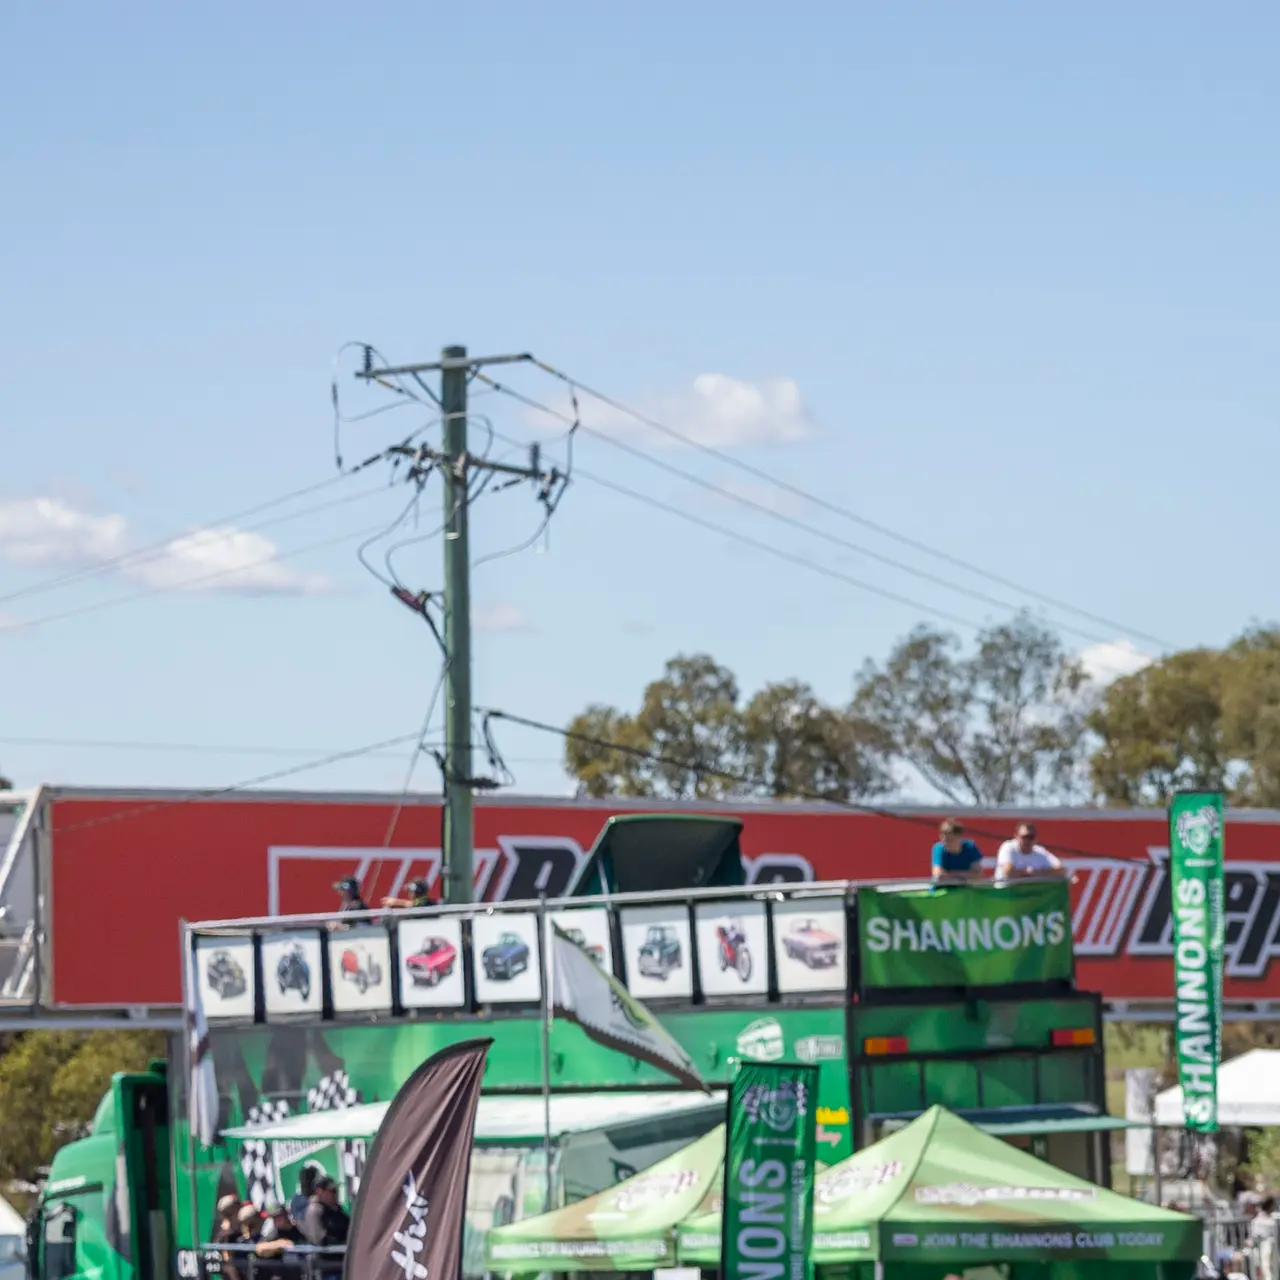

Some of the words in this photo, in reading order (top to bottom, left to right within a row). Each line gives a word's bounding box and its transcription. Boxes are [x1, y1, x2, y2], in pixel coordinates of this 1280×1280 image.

[866, 910, 1066, 954] SHANNONS
[1177, 877, 1214, 1126] SHANNONS
[920, 1233, 957, 1248] JOIN
[959, 1233, 988, 1248] THE
[991, 1233, 1073, 1248] SHANNONS
[1076, 1233, 1114, 1248] CLUB
[1118, 1233, 1164, 1247] TODAY
